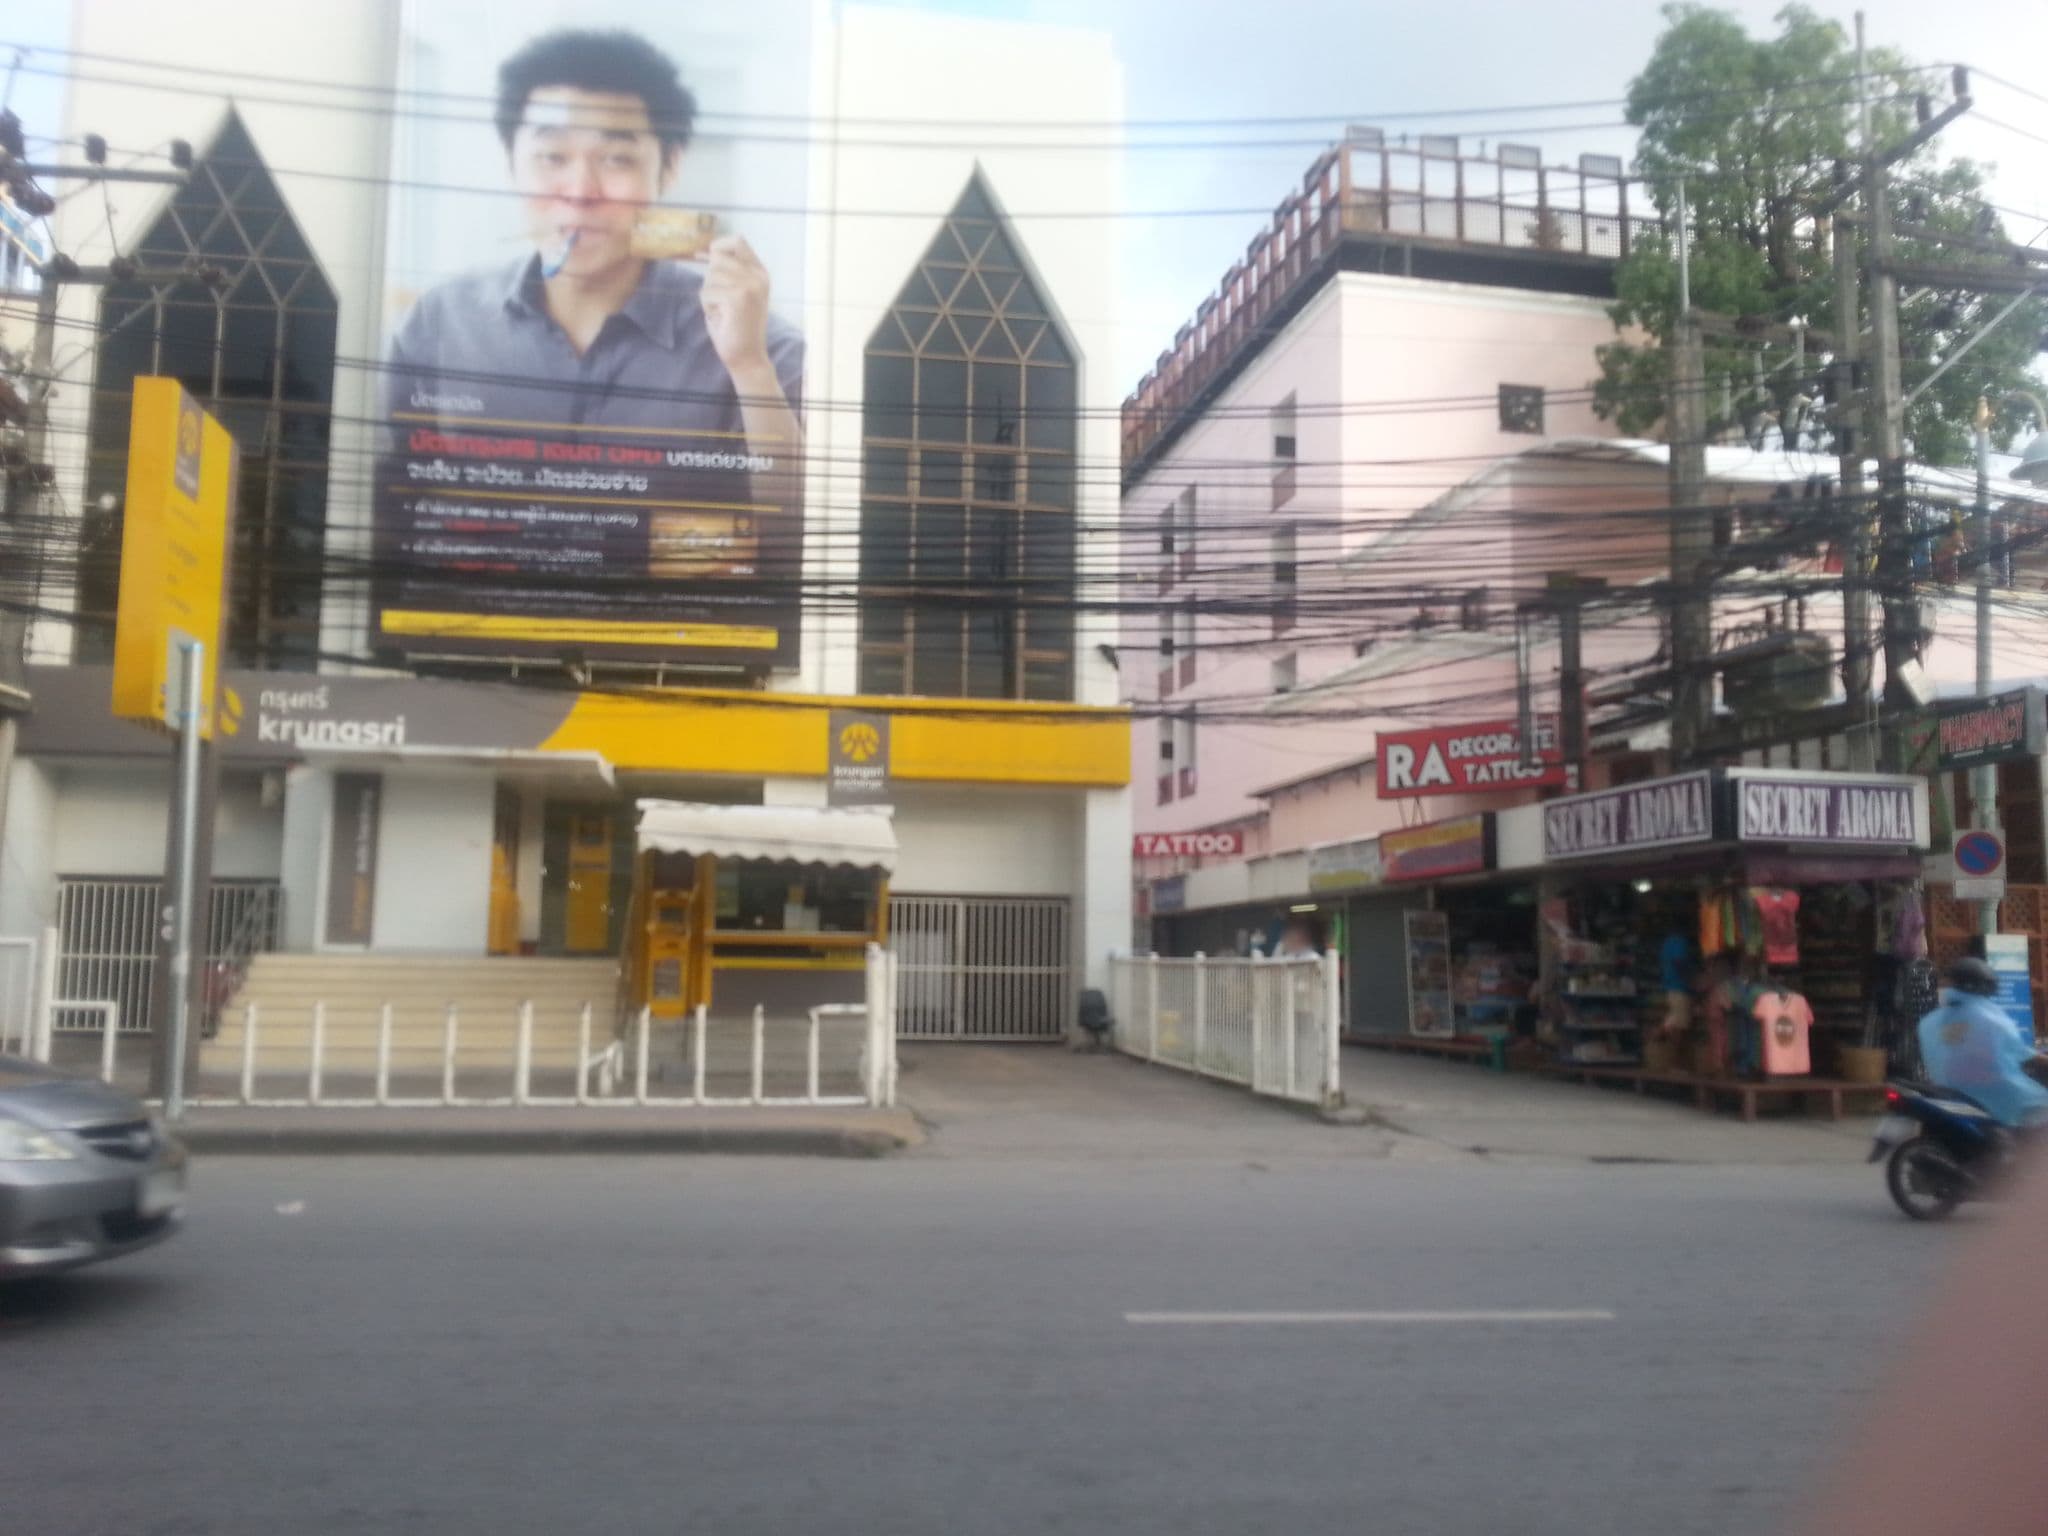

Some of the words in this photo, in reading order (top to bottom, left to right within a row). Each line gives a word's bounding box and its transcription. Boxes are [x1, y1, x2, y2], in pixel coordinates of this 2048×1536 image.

[1938, 700, 2024, 754] PHARMACY
[1385, 741, 1453, 790] RA
[1547, 796, 1623, 855] SECRET
[1624, 779, 1707, 843] AROMA
[1746, 783, 1831, 838] SECRET
[1837, 787, 1914, 841] AROMA
[1137, 833, 1236, 855] TATTOO
